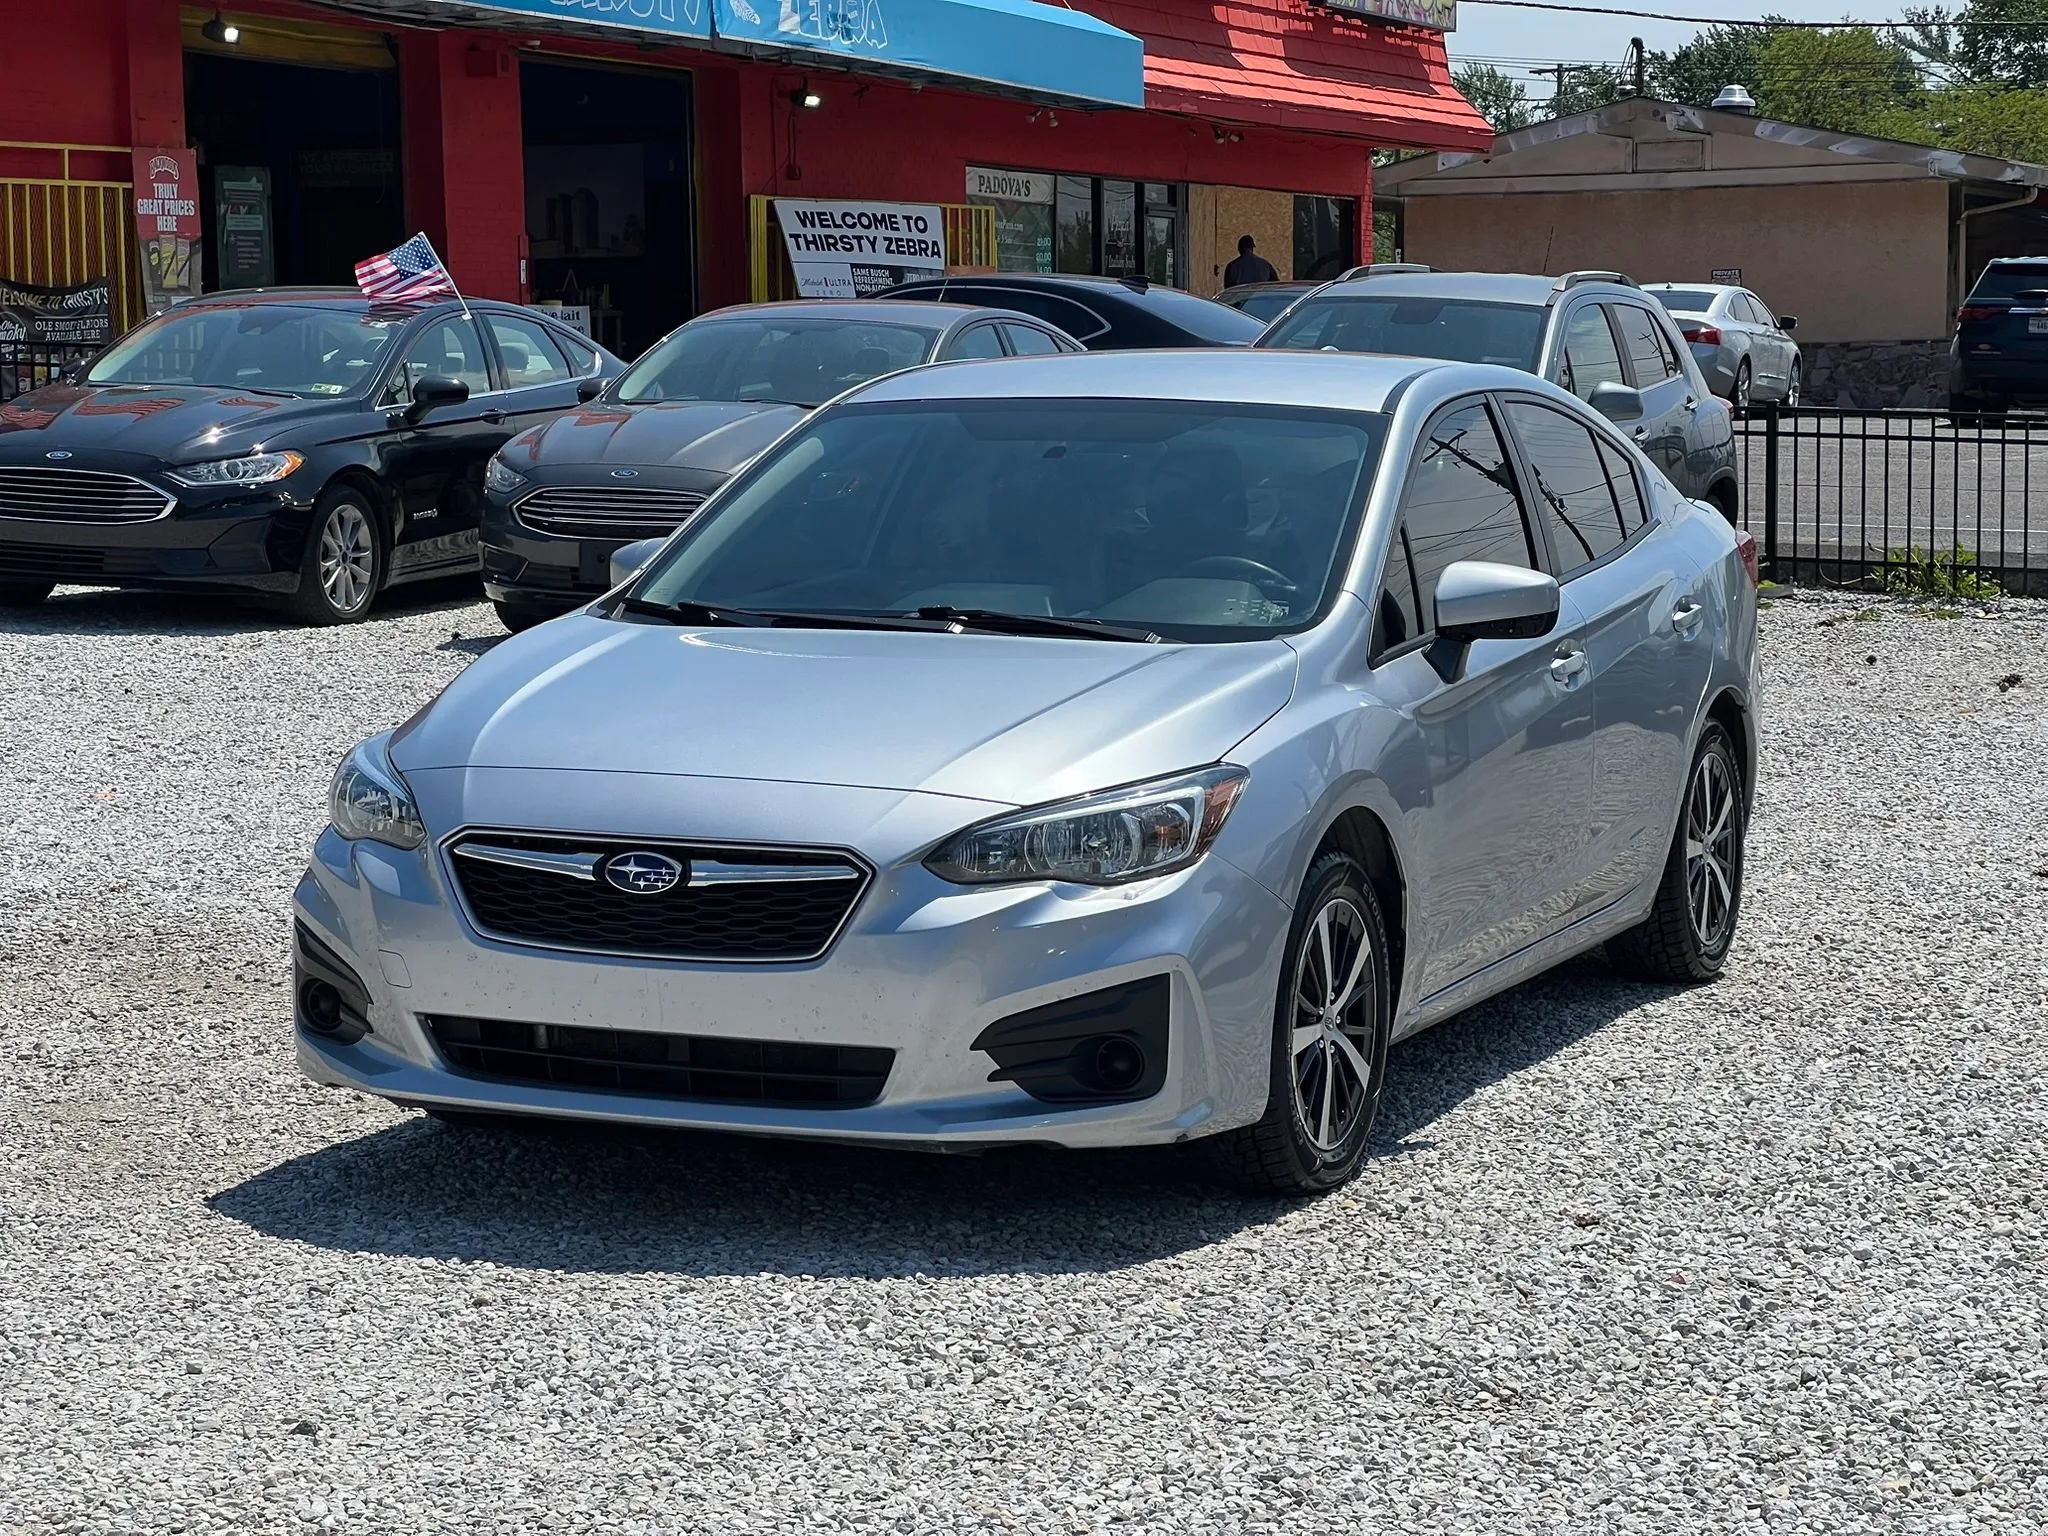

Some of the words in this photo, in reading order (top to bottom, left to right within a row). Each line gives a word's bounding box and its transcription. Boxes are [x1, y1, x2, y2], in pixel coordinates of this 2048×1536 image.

[153, 183, 178, 199] TRULY
[978, 175, 1031, 197] PADOVA'S
[137, 199, 163, 215] GREAT
[164, 200, 195, 216] PRICES
[157, 216, 177, 232] HERE
[794, 210, 901, 232] WELCOME
[902, 215, 928, 234] TO
[789, 233, 878, 254] THIRSTY
[883, 236, 942, 259] ZEBRA
[852, 268, 870, 277] SAME
[870, 269, 889, 278] BUSCH
[35, 321, 53, 331] OLE
